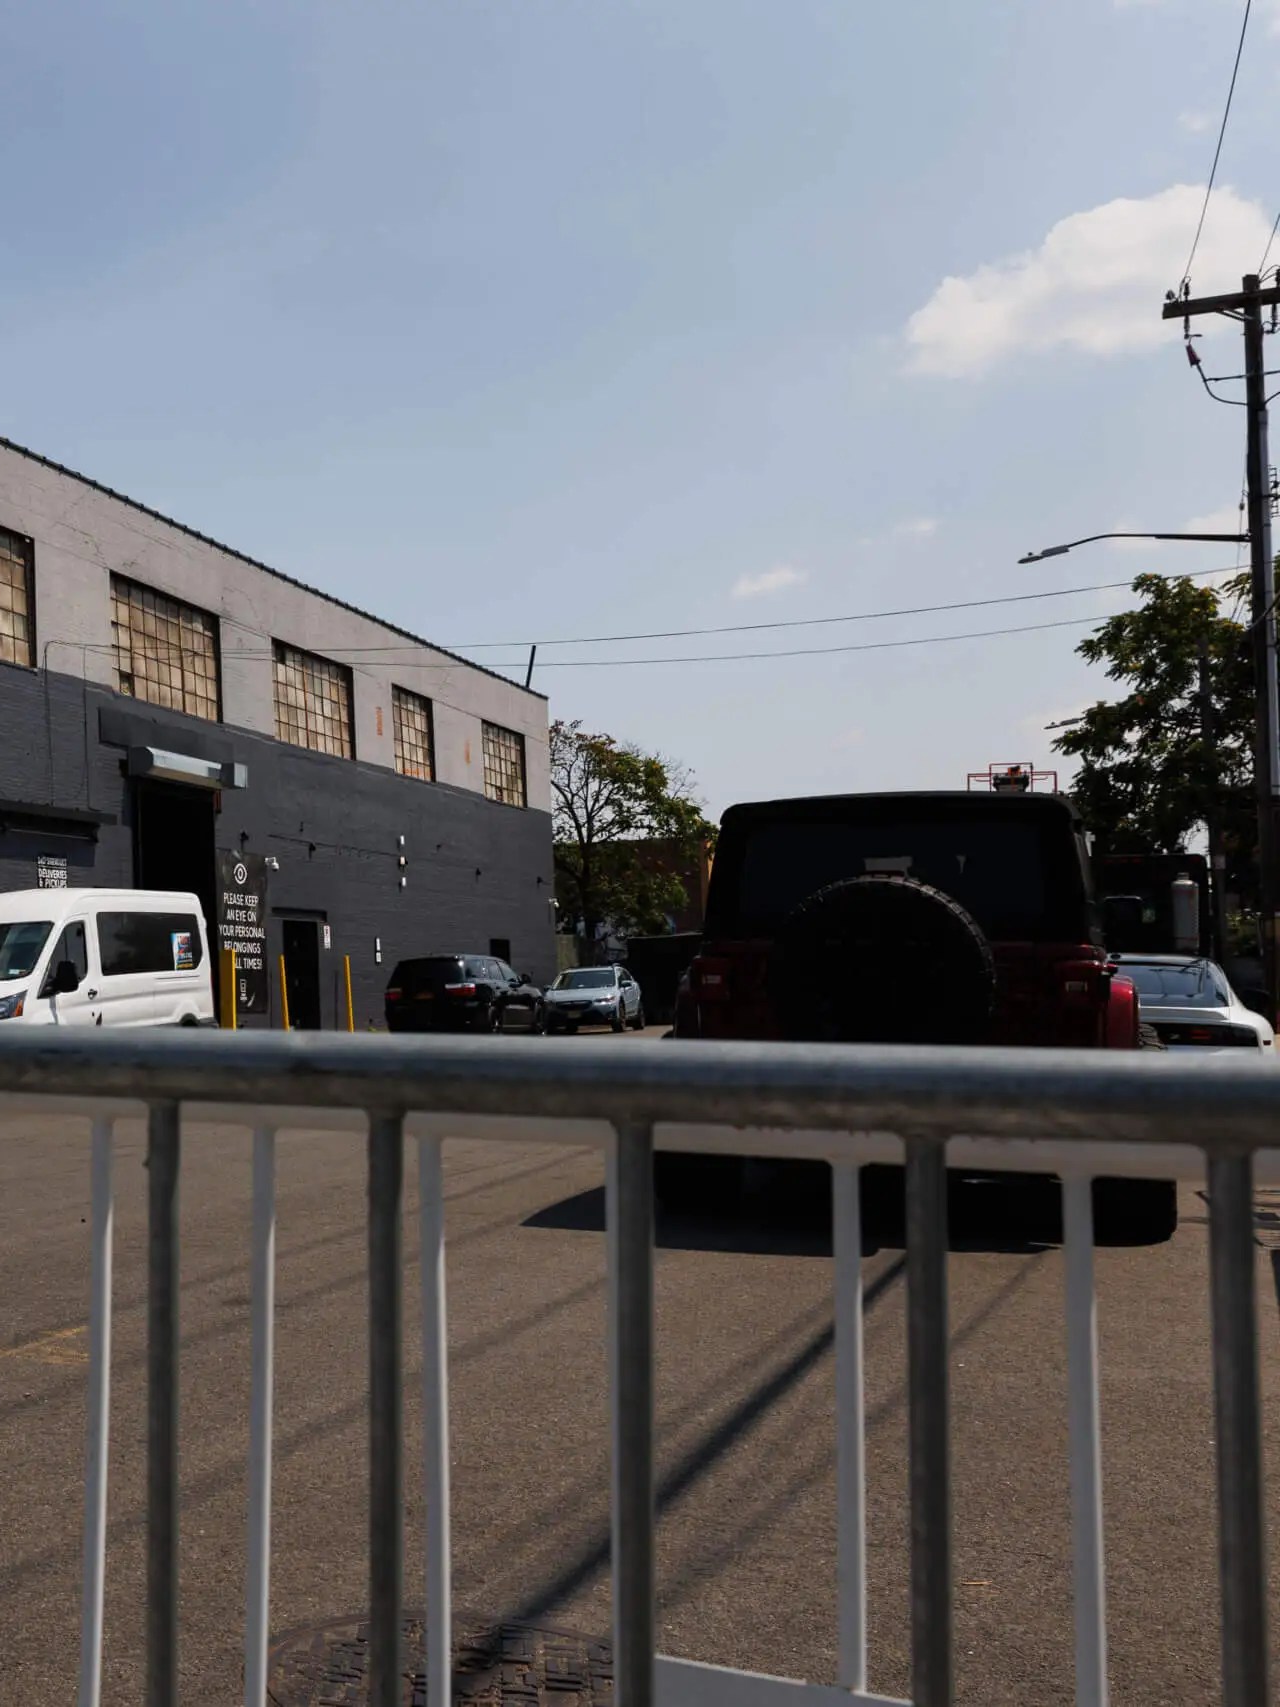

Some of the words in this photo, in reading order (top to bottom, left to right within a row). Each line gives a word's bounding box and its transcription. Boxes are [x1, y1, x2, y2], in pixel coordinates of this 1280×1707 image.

[38, 868, 67, 879] DELIVERIES
[45, 878, 67, 888] PICKUPS
[223, 892, 243, 906] PLEASE
[245, 895, 259, 907] KEEP
[226, 909, 235, 920] AN
[236, 910, 246, 922] EYE
[247, 911, 257, 922] ON
[218, 924, 235, 936] YOUR
[235, 926, 265, 939] PERSONAL
[224, 940, 261, 953] BELONGINGS
[244, 958, 263, 970] TIMES!
